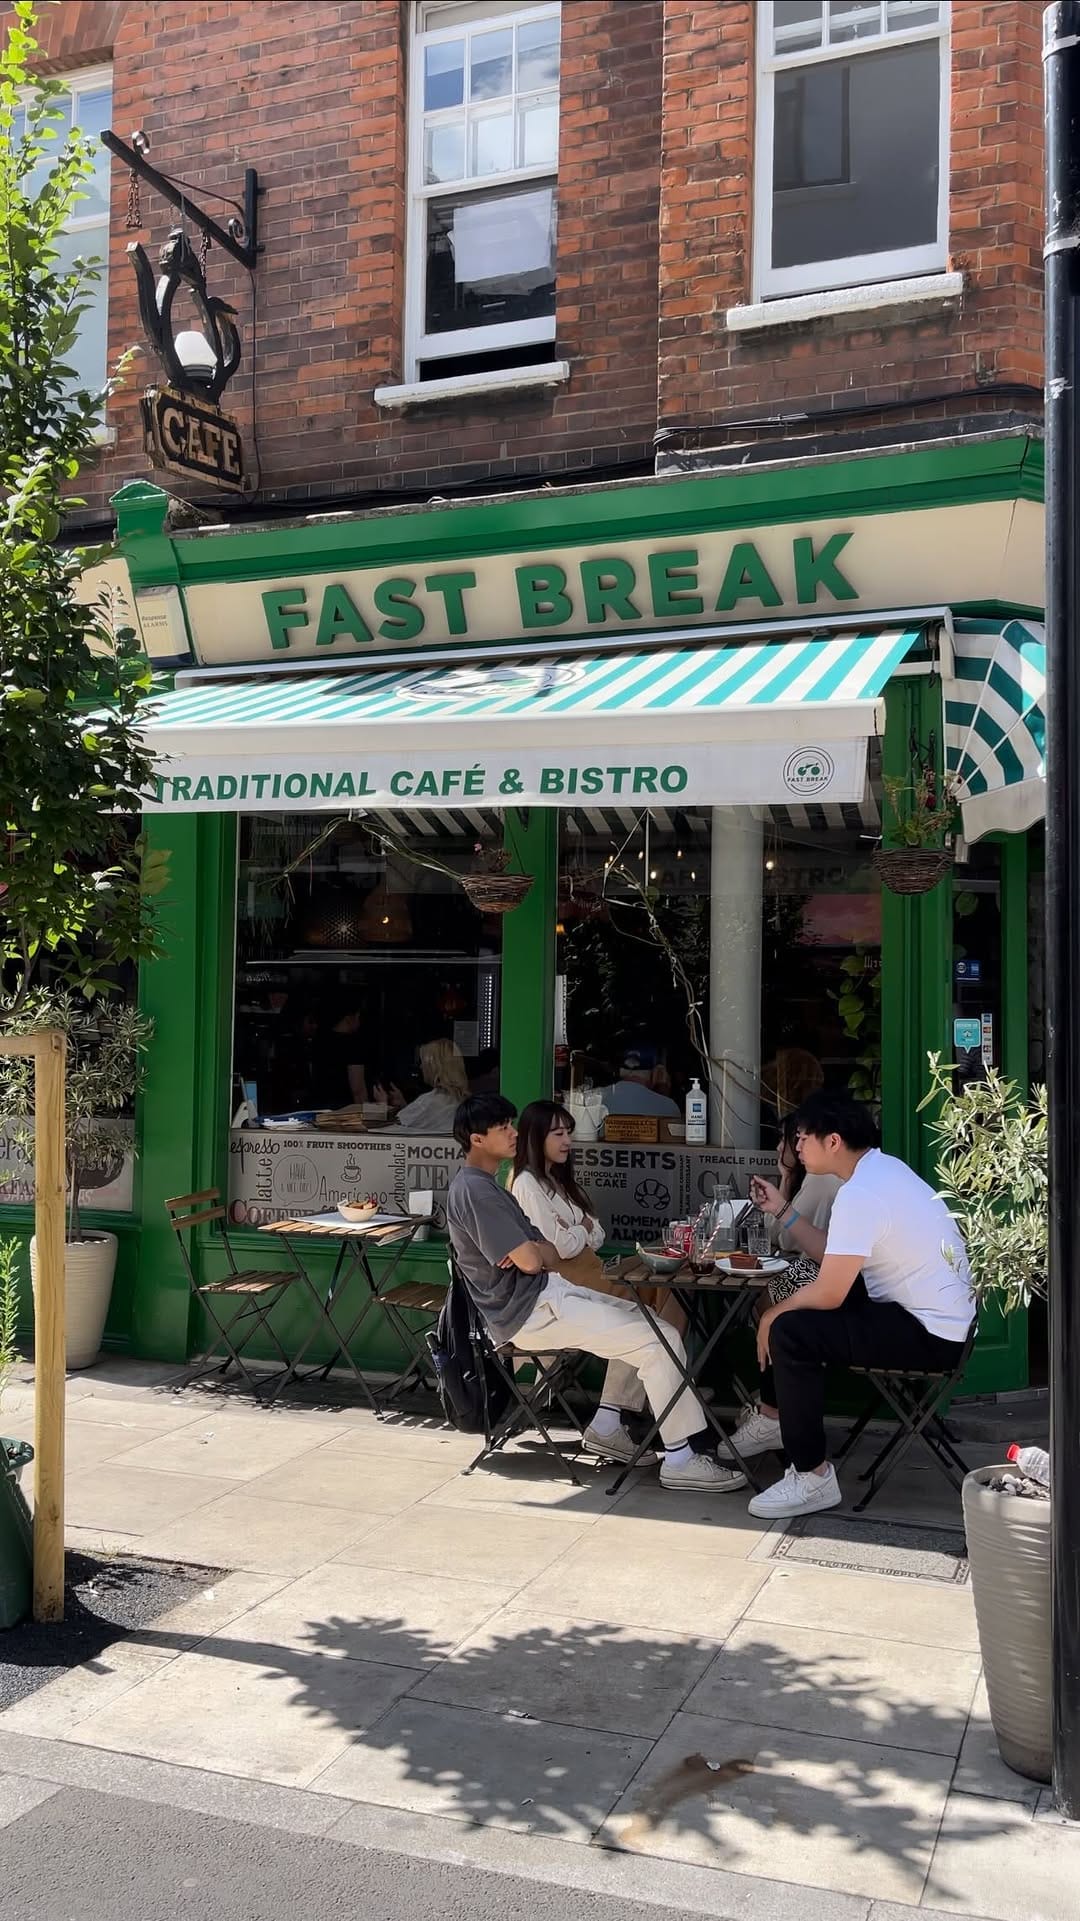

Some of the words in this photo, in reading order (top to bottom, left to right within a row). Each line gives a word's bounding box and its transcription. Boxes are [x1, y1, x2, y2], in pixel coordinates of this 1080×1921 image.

[163, 407, 240, 476] CAFE
[261, 571, 477, 650] FAST
[515, 533, 859, 629] BREAK
[156, 771, 376, 801] TRADITIONAL
[390, 763, 486, 796] CAFÉ
[499, 768, 524, 794] &
[540, 765, 688, 795] BISTRO
[230, 1137, 280, 1174] espresso
[306, 1141, 334, 1149] FRUIT
[337, 1141, 392, 1151] SMOOTHIES
[571, 1148, 677, 1170] ESSERTS
[699, 1155, 745, 1165] TREACLE
[749, 1157, 779, 1167] PUDD
[249, 1157, 272, 1203] latte
[387, 1143, 406, 1202] chocolate
[407, 1164, 461, 1191] TE
[583, 1170, 627, 1179] CHOCOLATE
[595, 1178, 627, 1189] CAKE
[230, 1199, 315, 1225] COFFE
[611, 1214, 687, 1228] HOMEMA
[611, 1228, 663, 1241] ALMON
